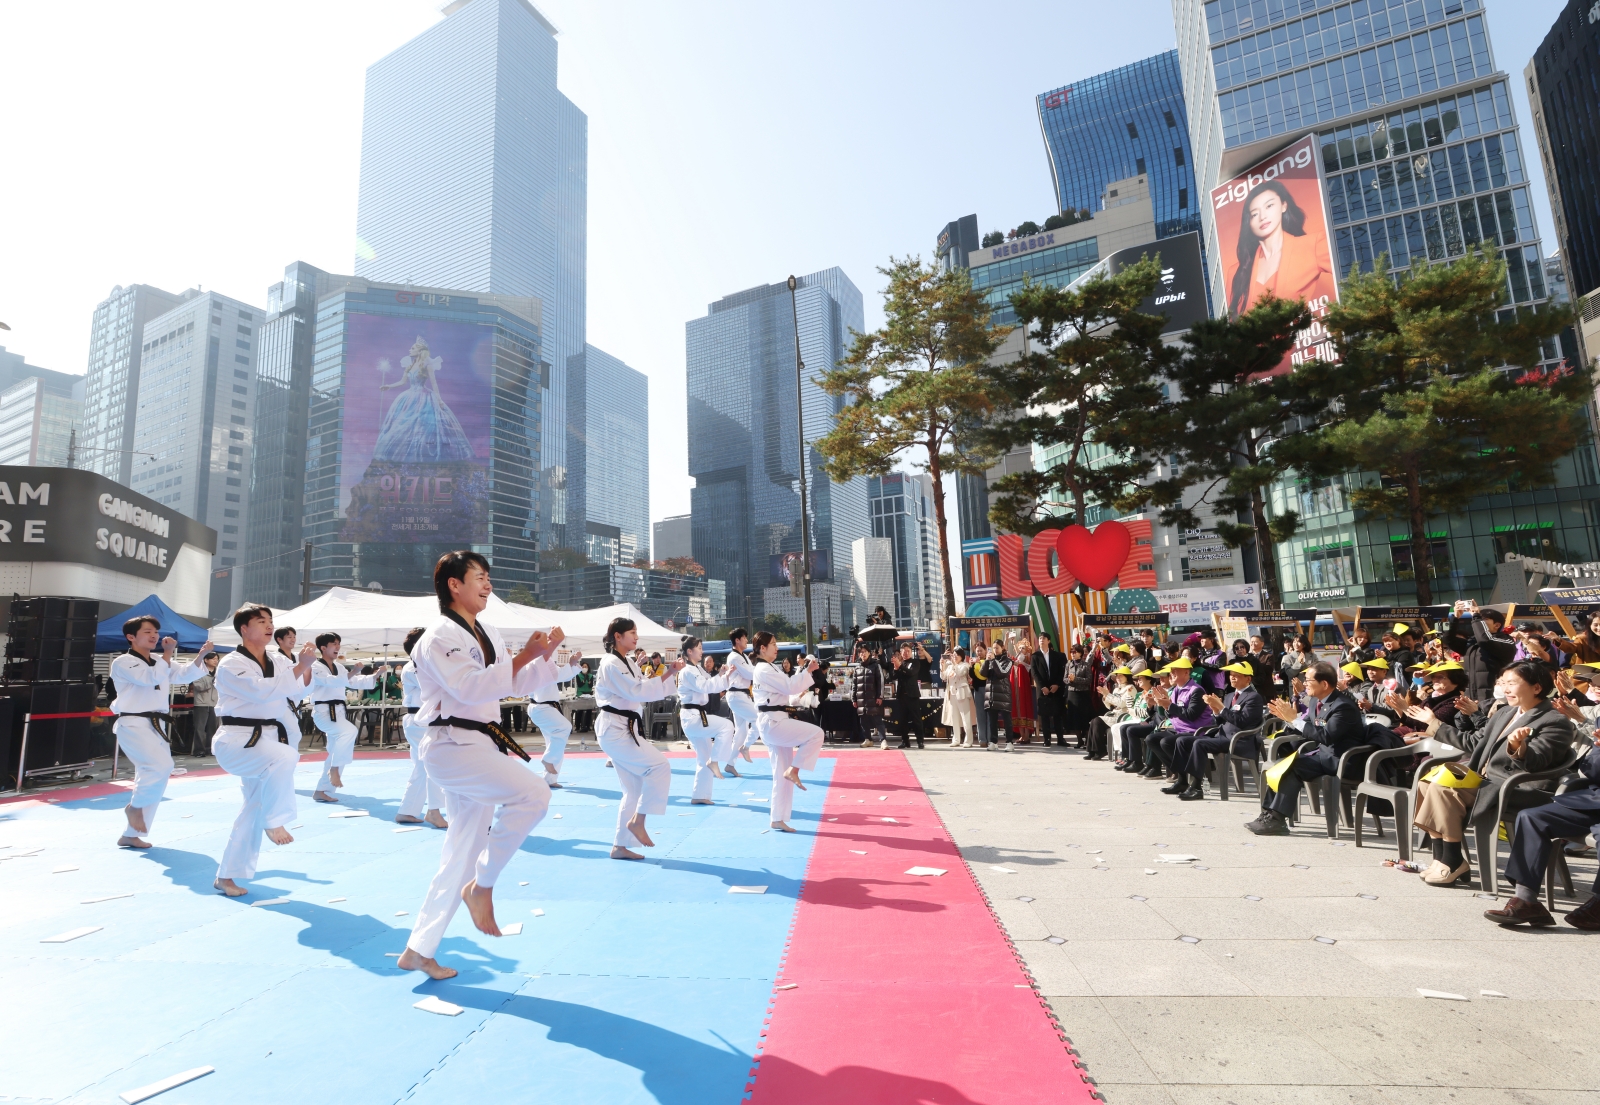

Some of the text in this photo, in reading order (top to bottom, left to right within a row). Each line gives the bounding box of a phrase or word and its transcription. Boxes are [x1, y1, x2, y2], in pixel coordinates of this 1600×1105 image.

[1045, 88, 1073, 108] GT
[1215, 146, 1312, 209] zigbang
[992, 233, 1055, 259] MEGABOX
[1155, 292, 1186, 305] UPbit
[379, 472, 453, 505] 위키드
[98, 493, 170, 538] GANGNAM
[391, 523, 412, 531] 전세계
[95, 527, 168, 569] SQUARE
[1298, 588, 1345, 600] OLIVE YOUNG
